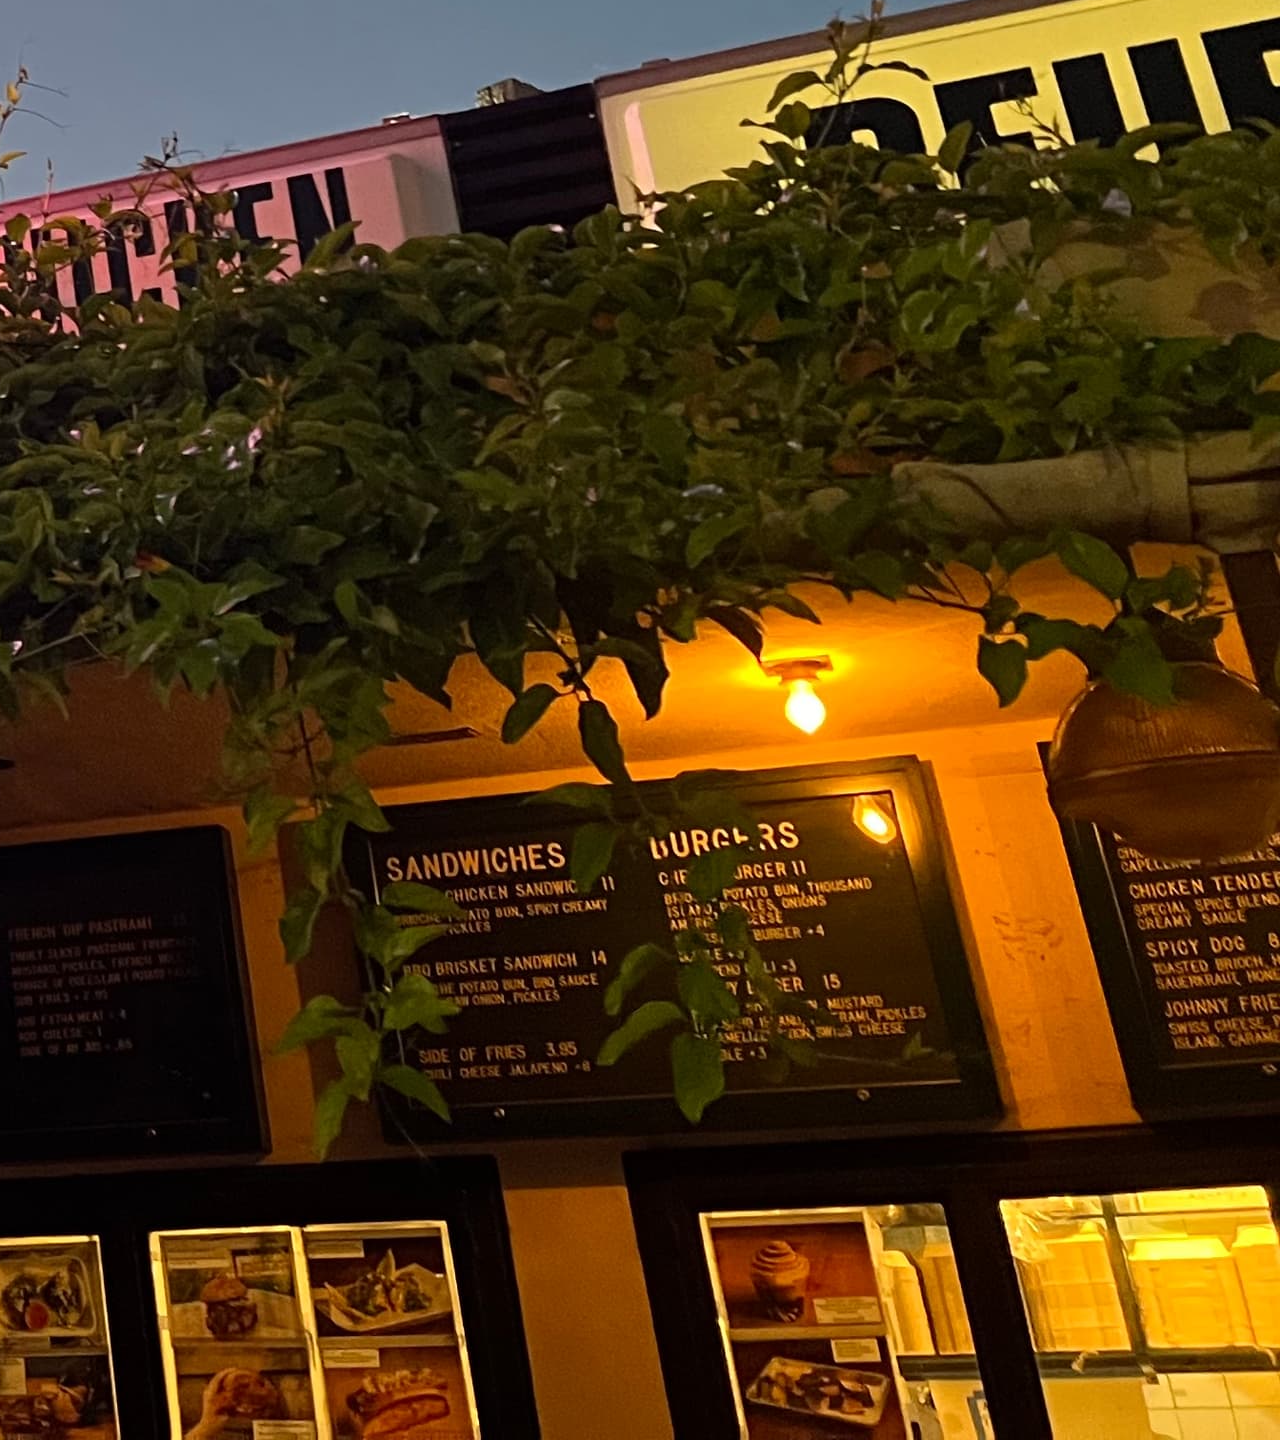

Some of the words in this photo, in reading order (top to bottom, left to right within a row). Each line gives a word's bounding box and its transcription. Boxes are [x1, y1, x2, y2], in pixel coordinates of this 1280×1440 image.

[386, 841, 567, 883] SANDWICHES
[792, 859, 807, 877] 11
[444, 884, 509, 904] CHICKEN
[515, 878, 581, 900] SANDWIC
[600, 875, 616, 893] 11
[806, 876, 873, 895] THOUSAND
[1128, 878, 1205, 900] CHICKEN
[561, 898, 609, 914] CREAMY
[1133, 900, 1187, 918] SPECIAL
[1194, 896, 1234, 913] SPICE
[88, 915, 153, 935] PASTRAMI
[1136, 911, 1193, 931] CREAMY
[1201, 907, 1247, 926] SAUCE
[1145, 938, 1200, 958] SPICY
[1208, 935, 1246, 955] DOG
[435, 957, 497, 976] BRISKET
[503, 952, 578, 972] SANDWICH
[590, 949, 608, 966] 14
[1152, 959, 1209, 976] TOASTED
[558, 972, 600, 988] SAUCE
[822, 973, 843, 991] 15
[826, 994, 884, 1010] MUSTARD
[1164, 997, 1229, 1018] JOHNNY
[858, 1022, 906, 1035] CHEESE
[1168, 1019, 1210, 1035] SWISS
[418, 1048, 451, 1065] SIDE
[459, 1046, 476, 1062] OF
[485, 1044, 527, 1062] FRIES
[545, 1041, 579, 1058] 3.95
[459, 1064, 502, 1079] CHEESE
